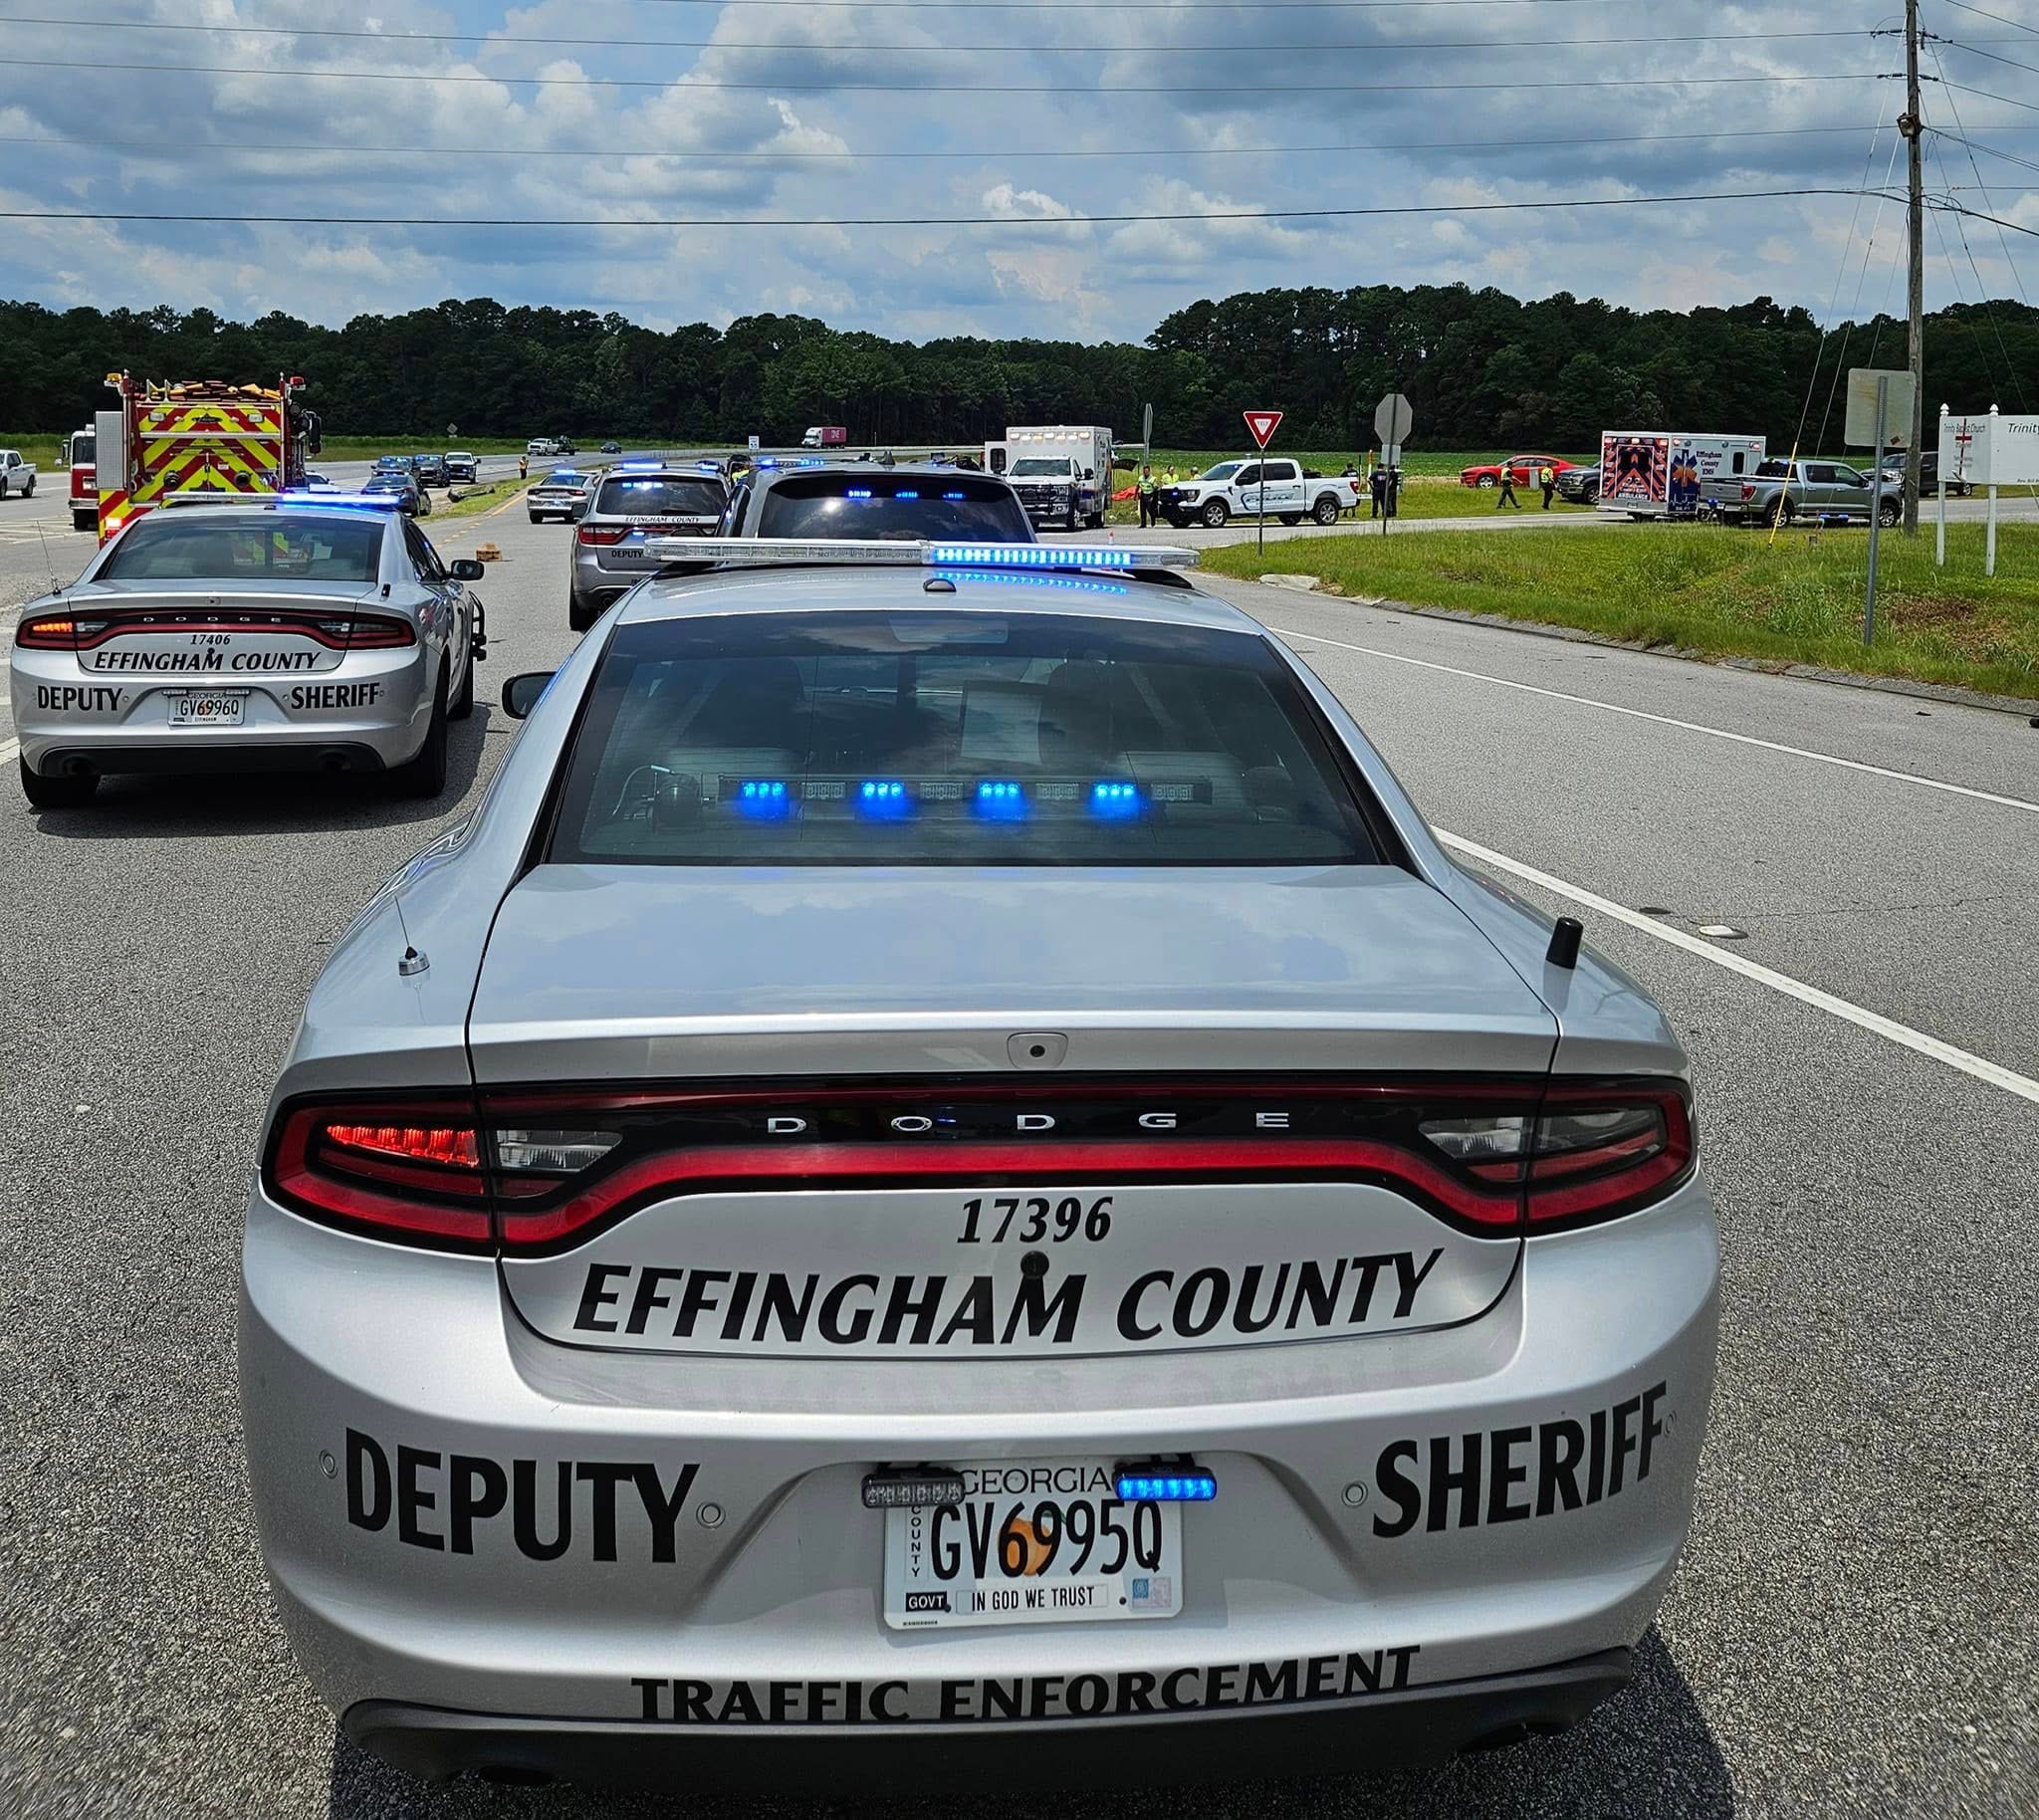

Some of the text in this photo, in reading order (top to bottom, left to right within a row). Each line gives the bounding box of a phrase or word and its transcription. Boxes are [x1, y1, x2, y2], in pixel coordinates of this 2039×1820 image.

[1696, 450, 1722, 459] Effingham
[190, 634, 232, 645] 17406
[94, 651, 323, 671] EFFINGHAM COUNTY
[37, 685, 124, 712] DEPUTY
[180, 699, 239, 716] GV6996Q
[291, 682, 380, 710] SHERIFF
[767, 1111, 1290, 1134] DODGE
[957, 1196, 1114, 1245] 17396
[572, 1247, 1445, 1346] EFFINGHAM COUNTY
[1372, 1380, 1668, 1539] SHERIFF
[960, 1467, 1115, 1495] GEORGIA
[344, 1427, 700, 1564] DEPUTY
[911, 1504, 922, 1578] COUNTY
[931, 1498, 1163, 1581] GV6995Q
[907, 1594, 944, 1611] GOVT
[971, 1585, 1095, 1612] IN GOD WE TRUST
[630, 1645, 1421, 1723] TRAFFIC ENFORCEMENT
